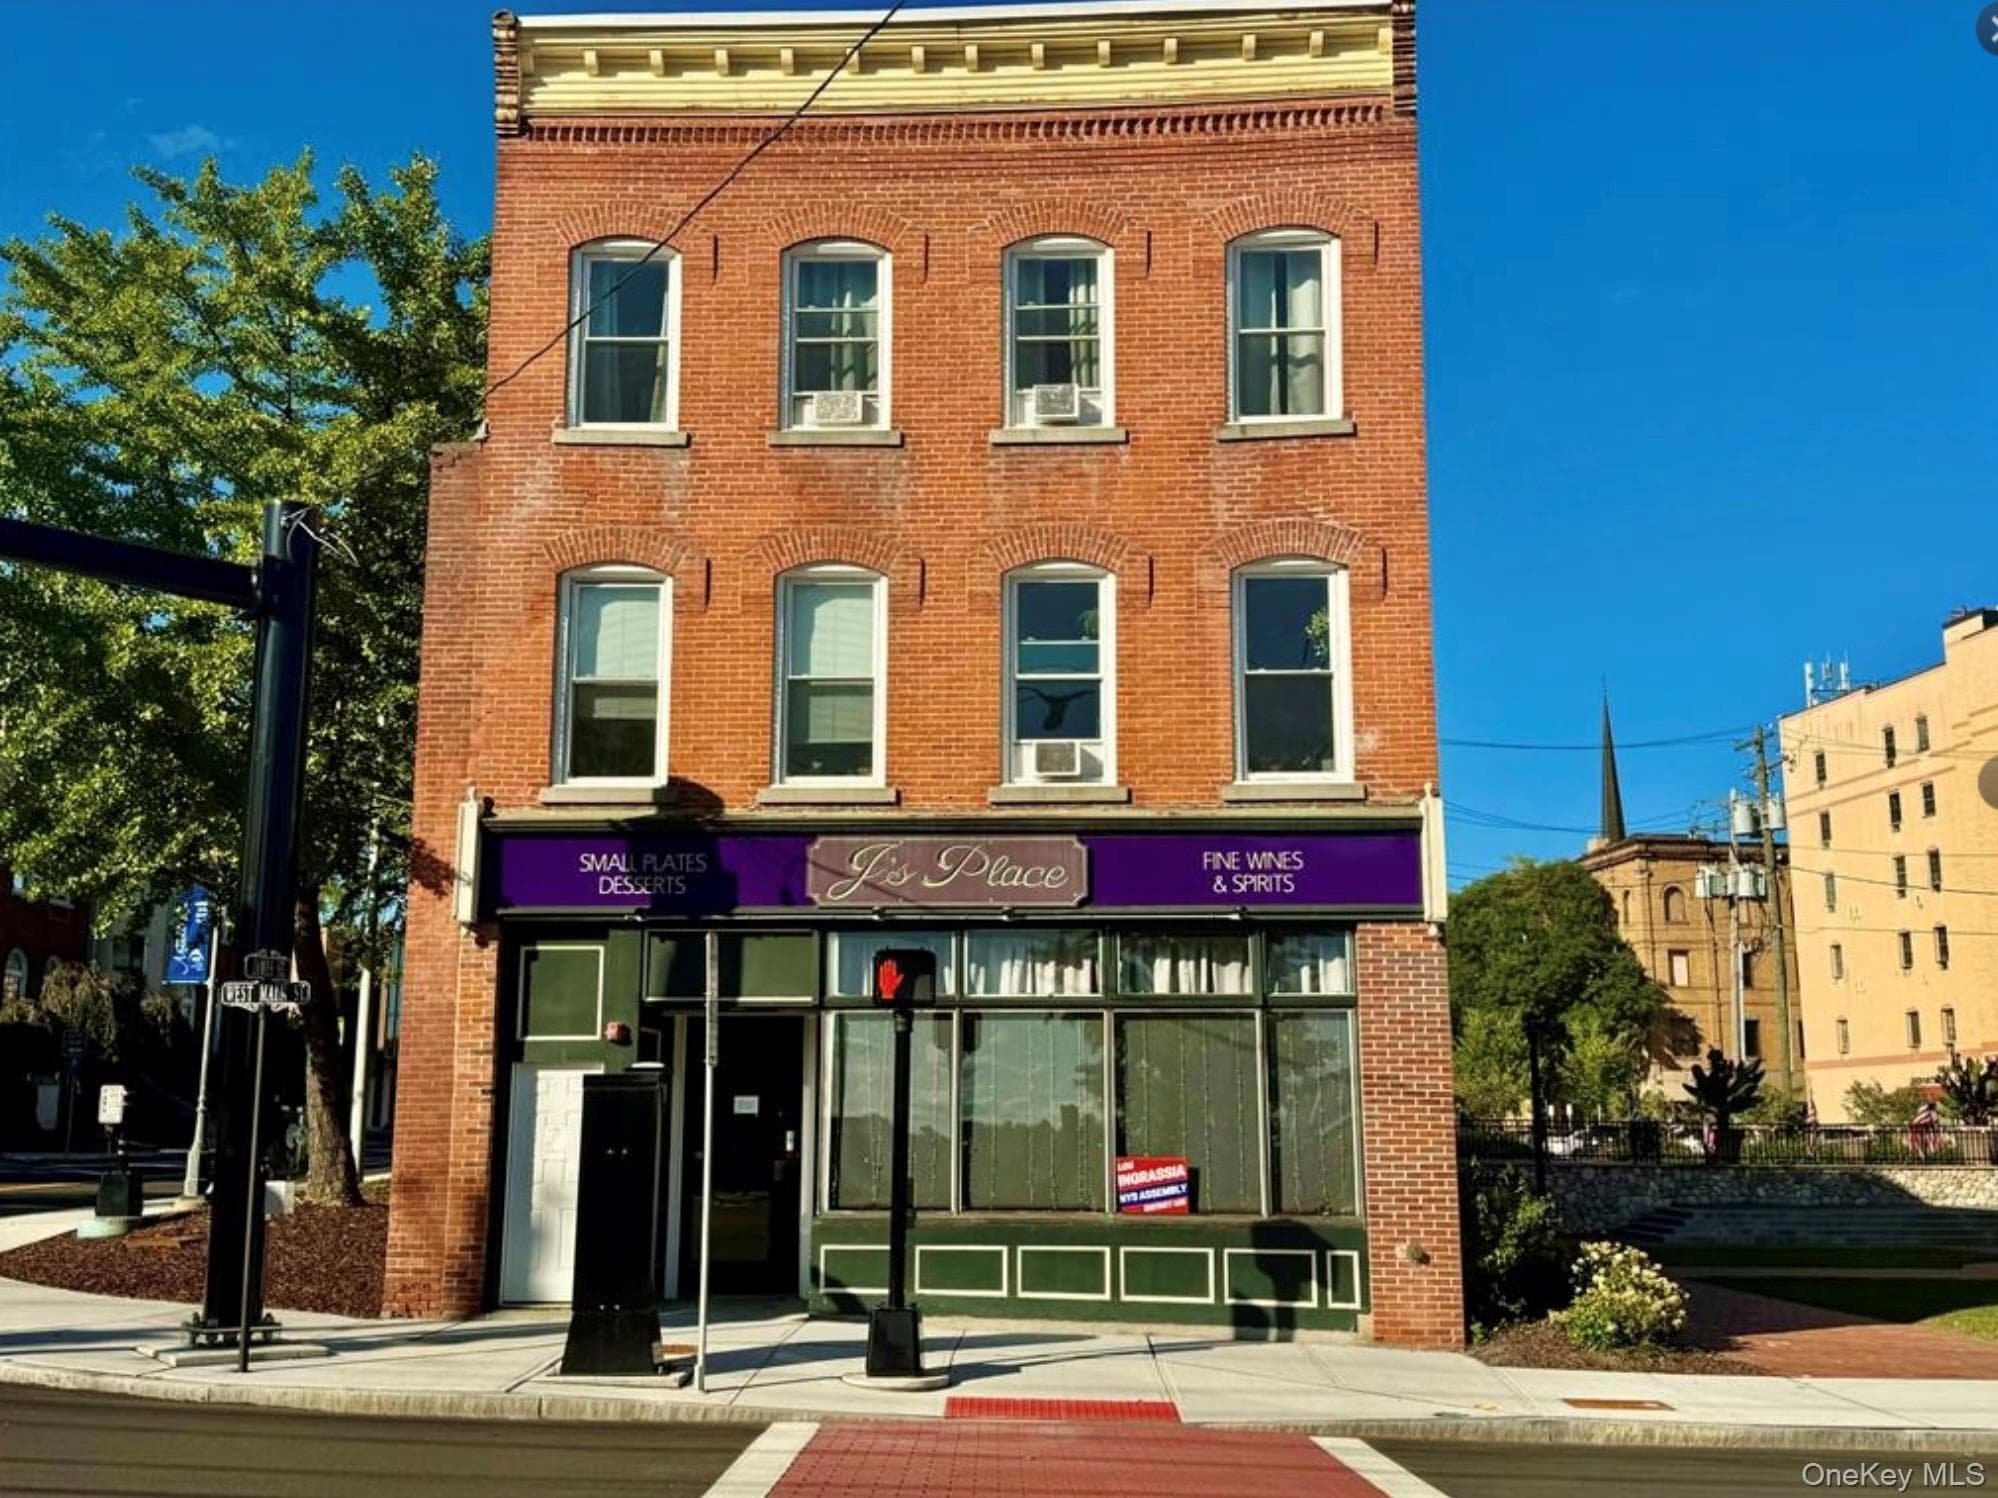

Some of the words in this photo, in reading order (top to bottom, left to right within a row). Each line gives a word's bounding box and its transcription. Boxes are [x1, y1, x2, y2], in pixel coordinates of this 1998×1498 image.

[578, 853, 638, 873] SMALL
[641, 853, 708, 873] PLATES
[1203, 851, 1241, 870] FINE
[1245, 851, 1304, 870] WINES
[826, 843, 918, 901] J's
[922, 844, 1069, 889] Place
[598, 875, 687, 895] DESSERTS
[1213, 875, 1228, 893] &
[1232, 873, 1296, 893] SPIRITS
[225, 985, 254, 1001] WEST
